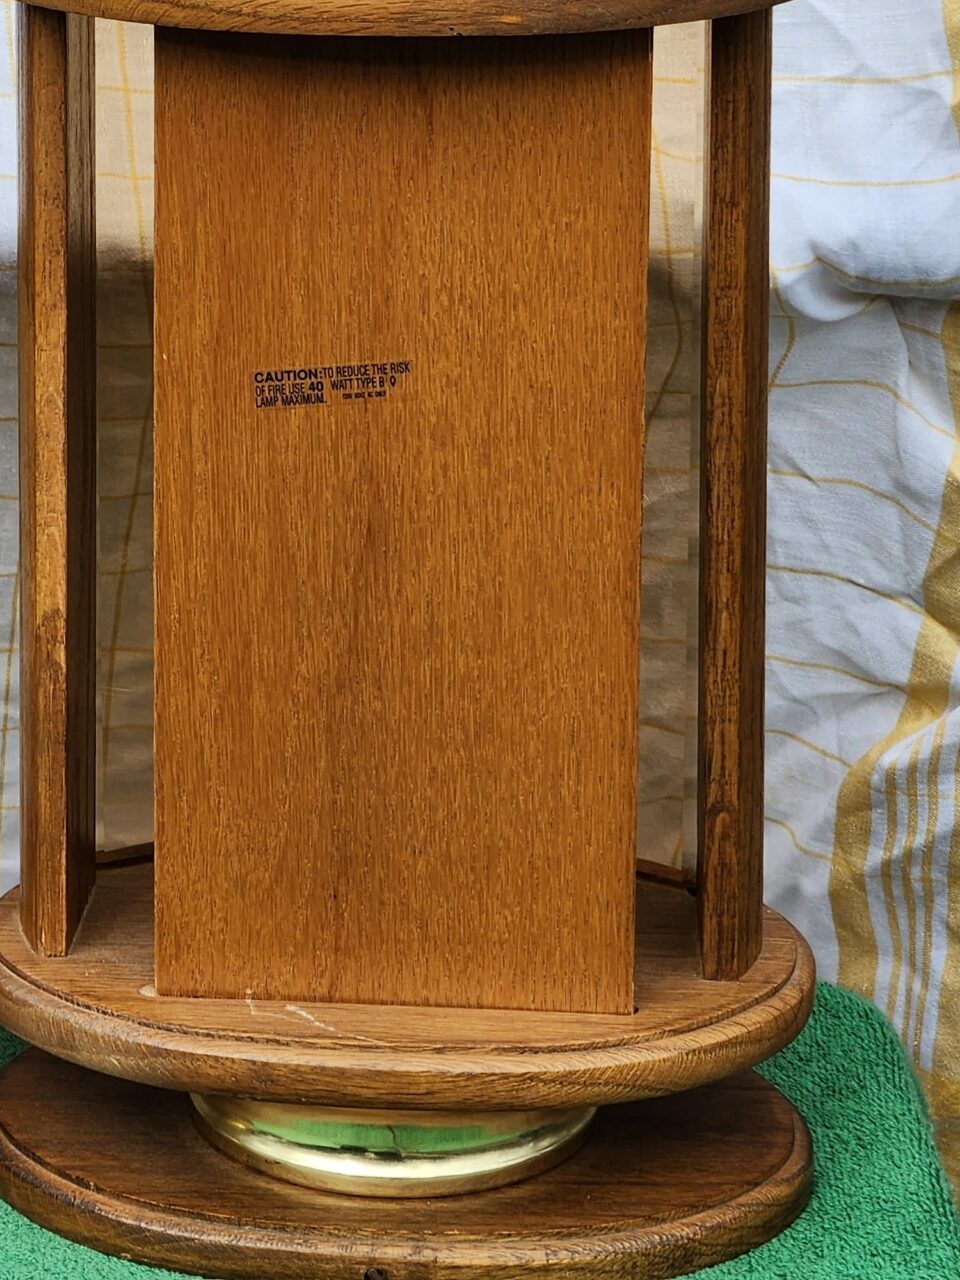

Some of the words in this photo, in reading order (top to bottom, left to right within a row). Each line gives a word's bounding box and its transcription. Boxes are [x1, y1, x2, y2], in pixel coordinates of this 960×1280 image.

[322, 367, 334, 379] TO
[336, 364, 370, 378] REDUCE
[371, 363, 388, 375] THE
[390, 361, 411, 374] RISK
[255, 385, 266, 397] OF
[267, 383, 286, 396] FIRE
[288, 382, 306, 395] USE
[308, 380, 325, 392] 40
[330, 378, 353, 391] WATT
[355, 376, 377, 389] TYPE
[378, 376, 385, 388] B
[255, 395, 279, 408] LAMP
